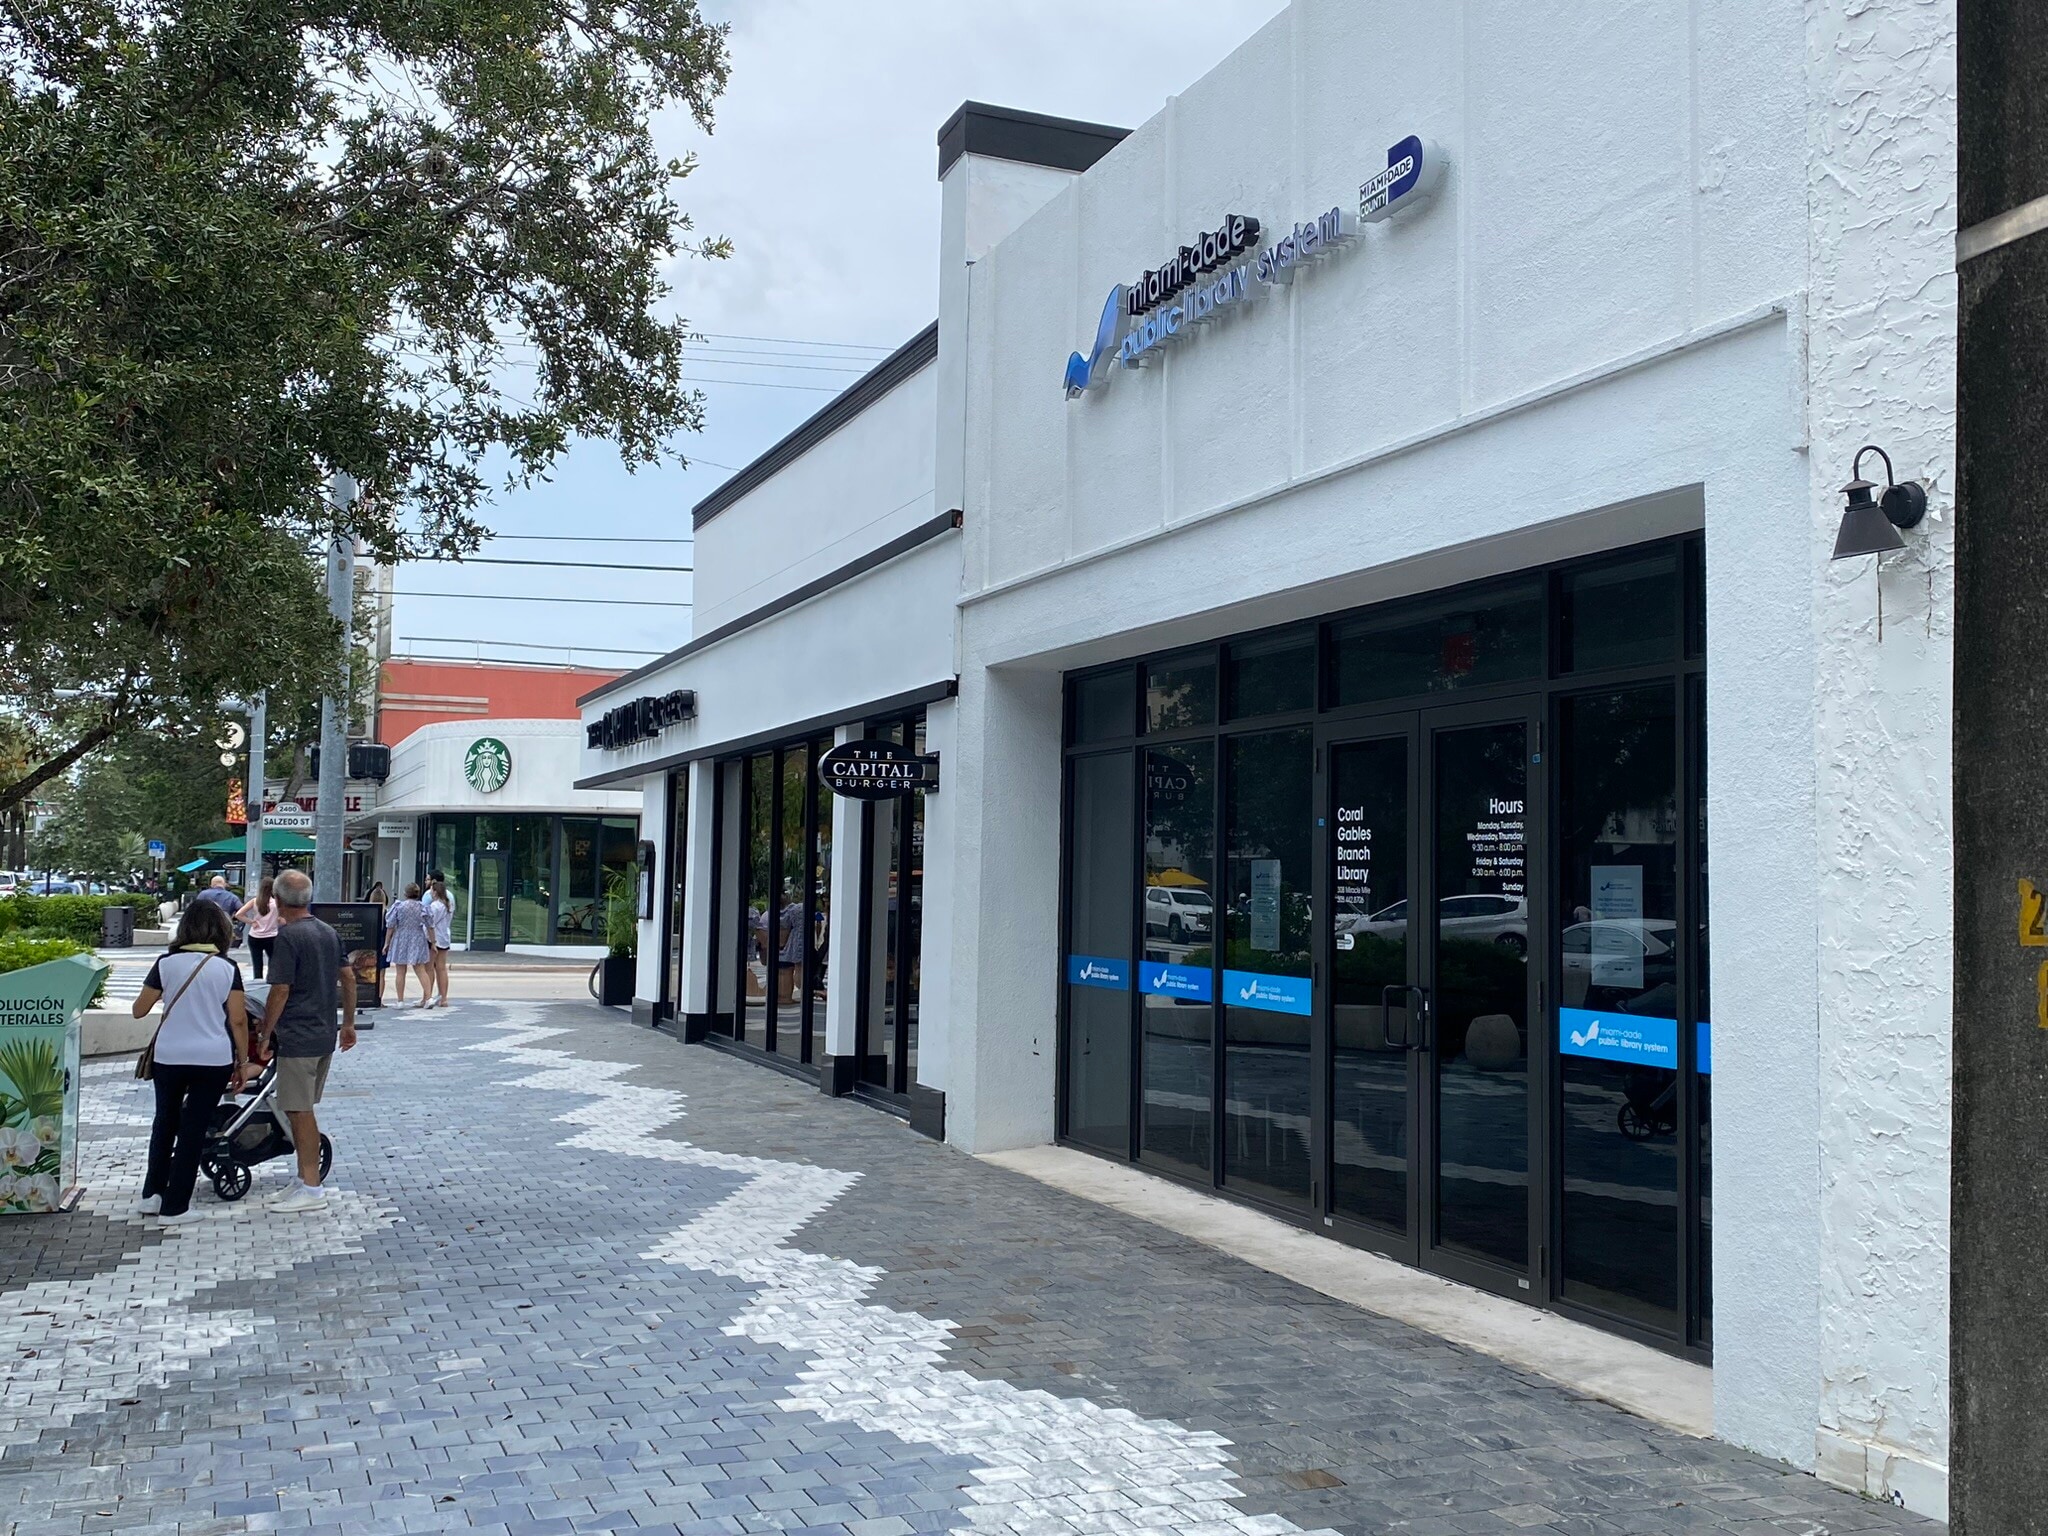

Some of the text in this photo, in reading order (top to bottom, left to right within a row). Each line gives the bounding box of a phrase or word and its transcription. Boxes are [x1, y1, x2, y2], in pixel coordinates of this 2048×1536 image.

[1360, 191, 1387, 218] COUNTY
[1126, 214, 1248, 315] miami-dade
[1121, 206, 1344, 370] public library system
[854, 750, 893, 760] THE
[832, 762, 914, 778] CAPITAL
[1337, 806, 1364, 822] Coral
[1489, 798, 1524, 814] Hours
[1337, 826, 1372, 841] Gables
[1499, 832, 1524, 841] Thursday
[486, 841, 498, 850] 292
[1337, 845, 1371, 861] Branch
[1475, 857, 1492, 866] Friday
[1499, 857, 1524, 866] Saturday
[1337, 865, 1369, 883] Library
[1502, 882, 1524, 892] Sunday
[0, 1013, 64, 1025] TERIALES
[1600, 1027, 1642, 1039] miami-dade
[1598, 1037, 1669, 1053] public library system
